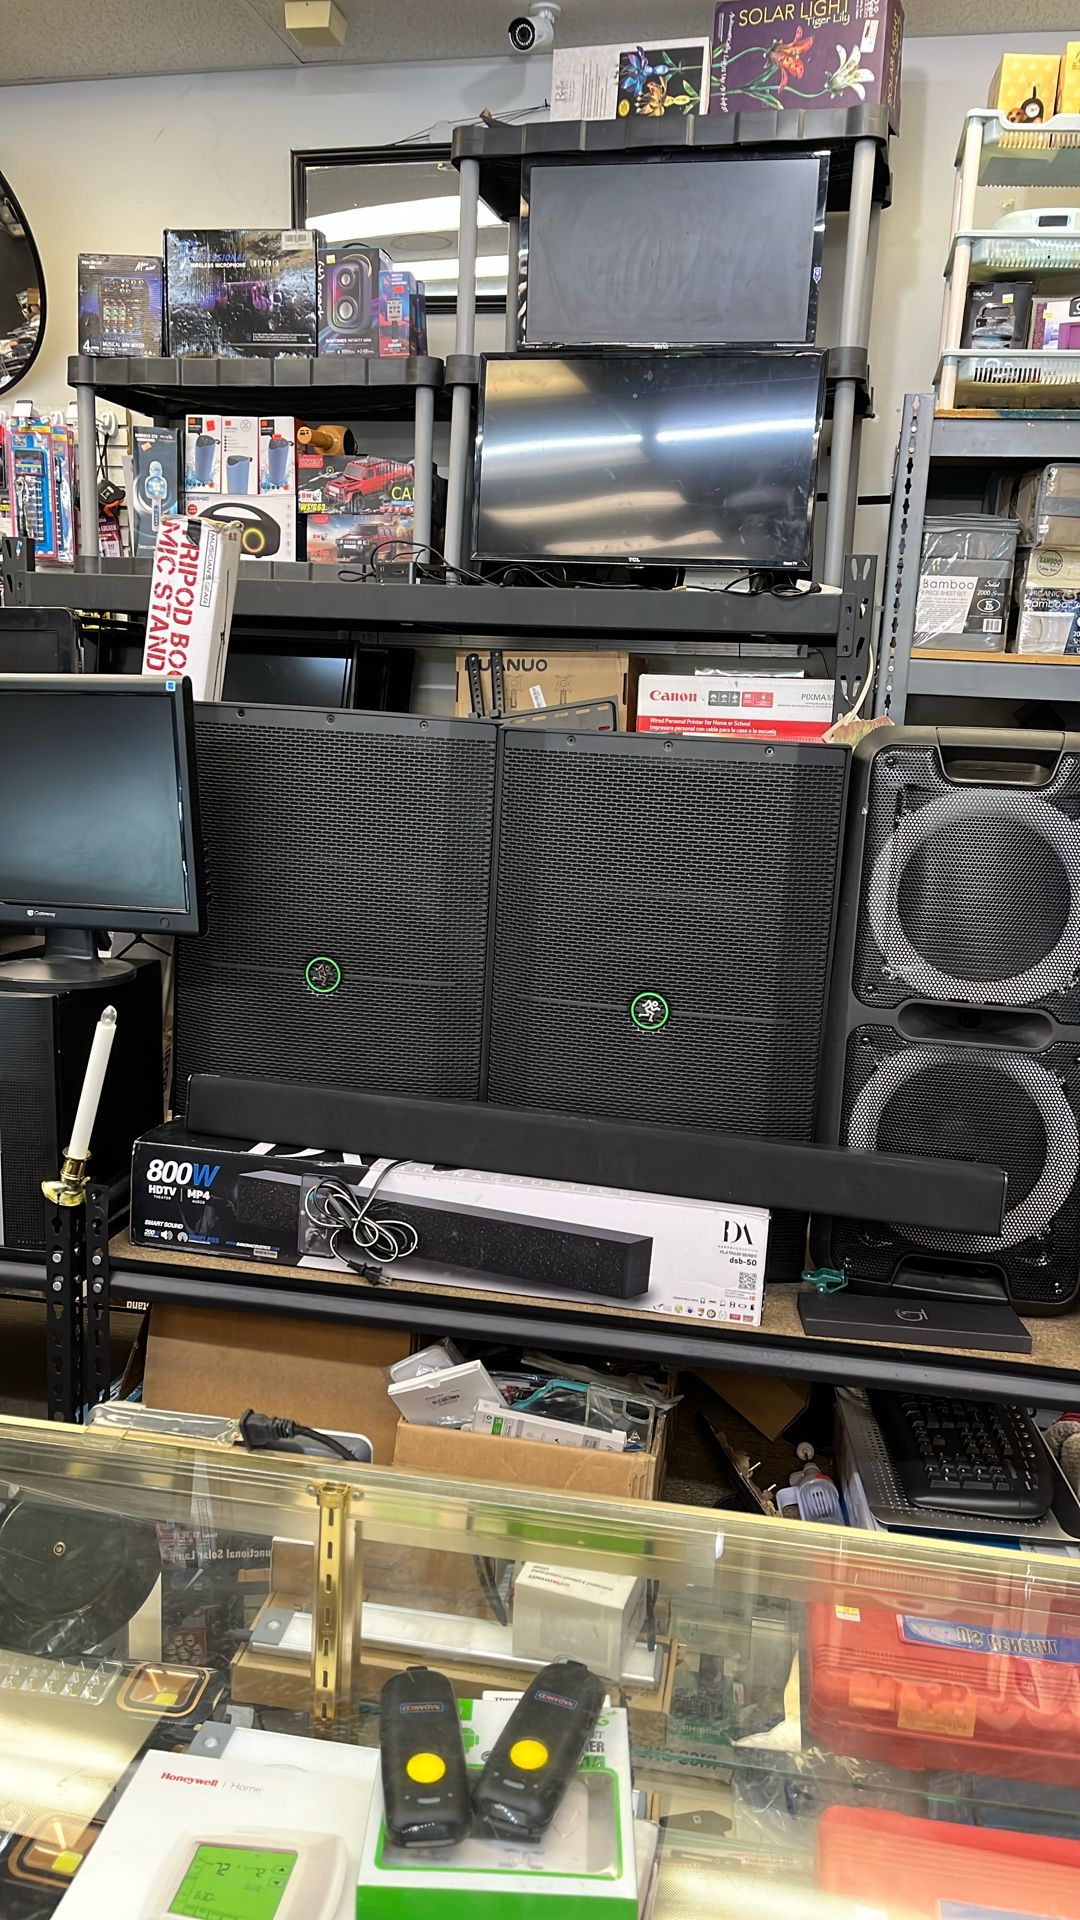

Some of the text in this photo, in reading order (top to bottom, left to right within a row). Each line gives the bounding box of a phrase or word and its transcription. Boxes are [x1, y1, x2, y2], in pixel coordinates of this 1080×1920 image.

[739, 4, 795, 27] SOLAR
[800, 0, 849, 18] LIGHT
[806, 12, 851, 29] Tiger Lily
[82, 339, 92, 352] 4
[391, 486, 415, 500] CA
[922, 579, 974, 589] Bamboo
[146, 521, 181, 671] MIC STAND
[202, 582, 214, 605] GEAR
[465, 659, 548, 672] UNUO
[649, 690, 697, 702] Canon
[801, 693, 825, 701] PIXMA
[146, 1159, 220, 1187] 800W
[148, 1184, 211, 1201] HDTV MP4
[144, 1219, 184, 1229] SMART SOUND
[719, 1250, 742, 1258] PLATINUM
[729, 1257, 757, 1266] dsb-50
[161, 1772, 263, 1793] Honeywell Home
